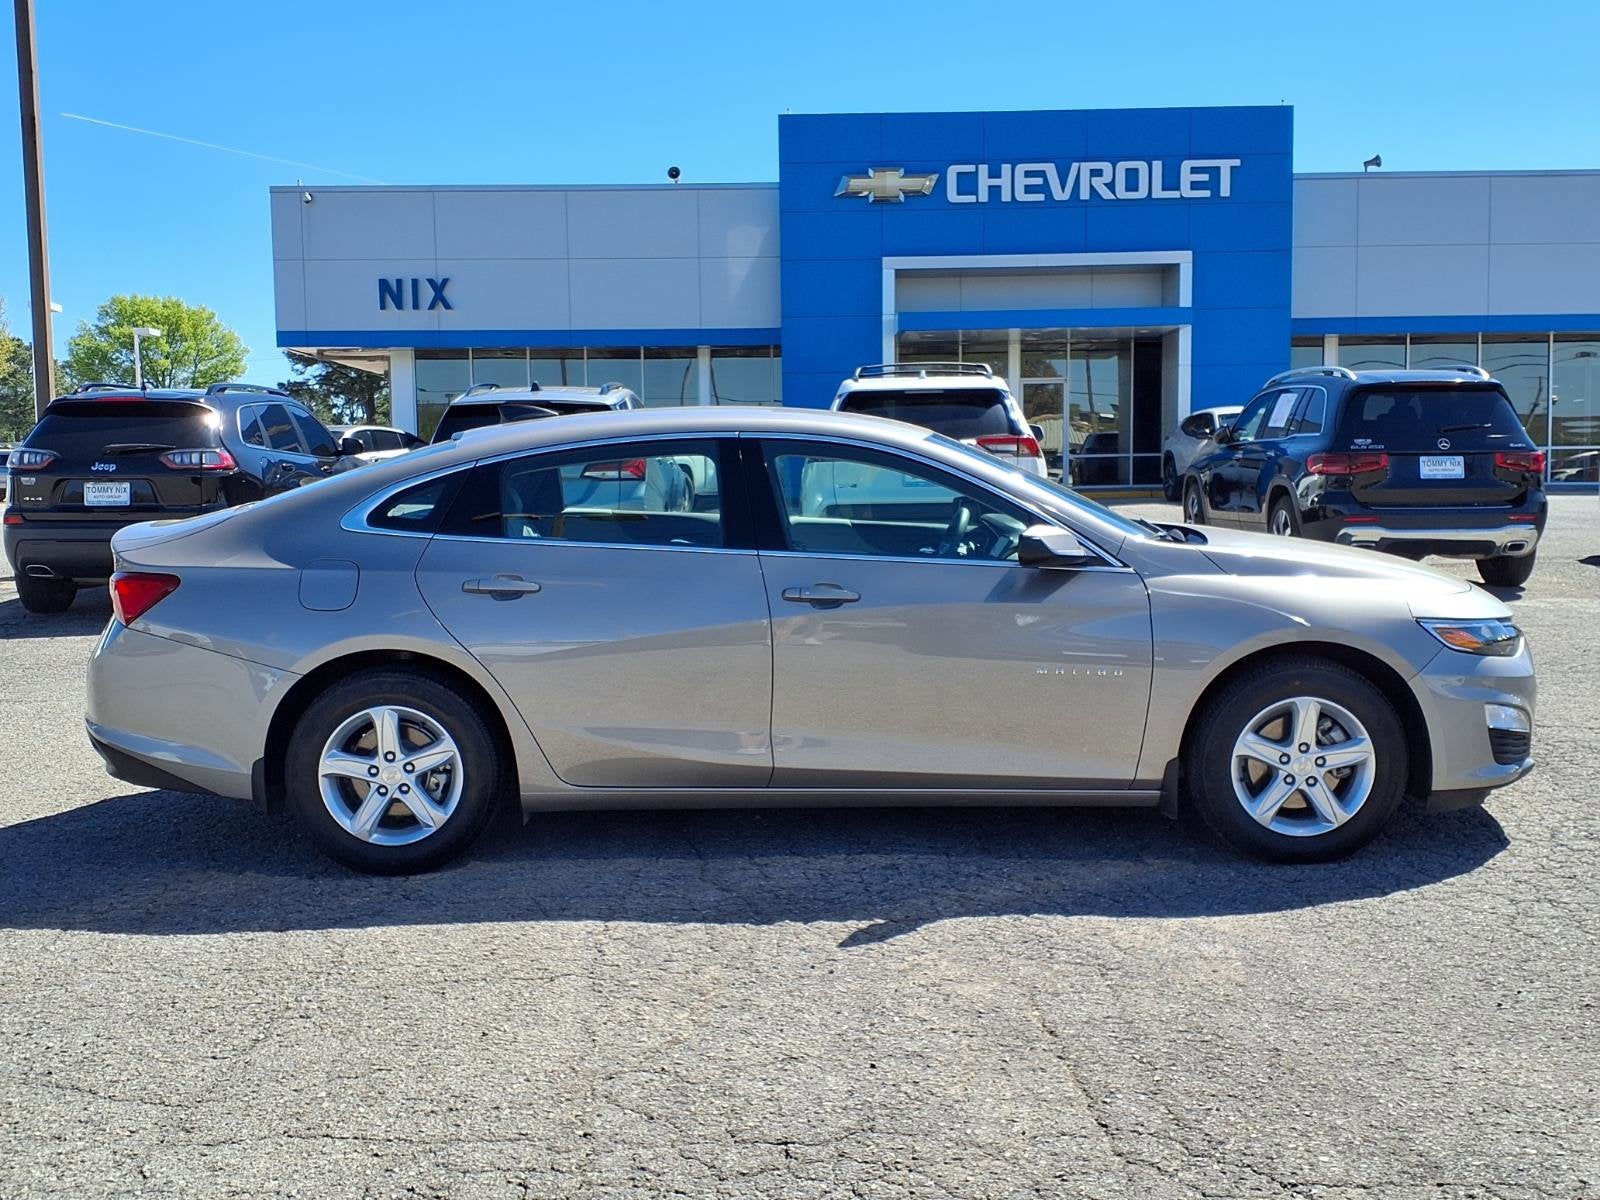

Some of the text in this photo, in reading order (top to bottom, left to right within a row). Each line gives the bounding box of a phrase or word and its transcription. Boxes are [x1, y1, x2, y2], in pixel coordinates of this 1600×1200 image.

[946, 159, 1241, 203] CHEVROLET
[378, 278, 453, 310] NIX
[91, 462, 116, 472] Jeep
[87, 486, 128, 494] TOMMY NIX
